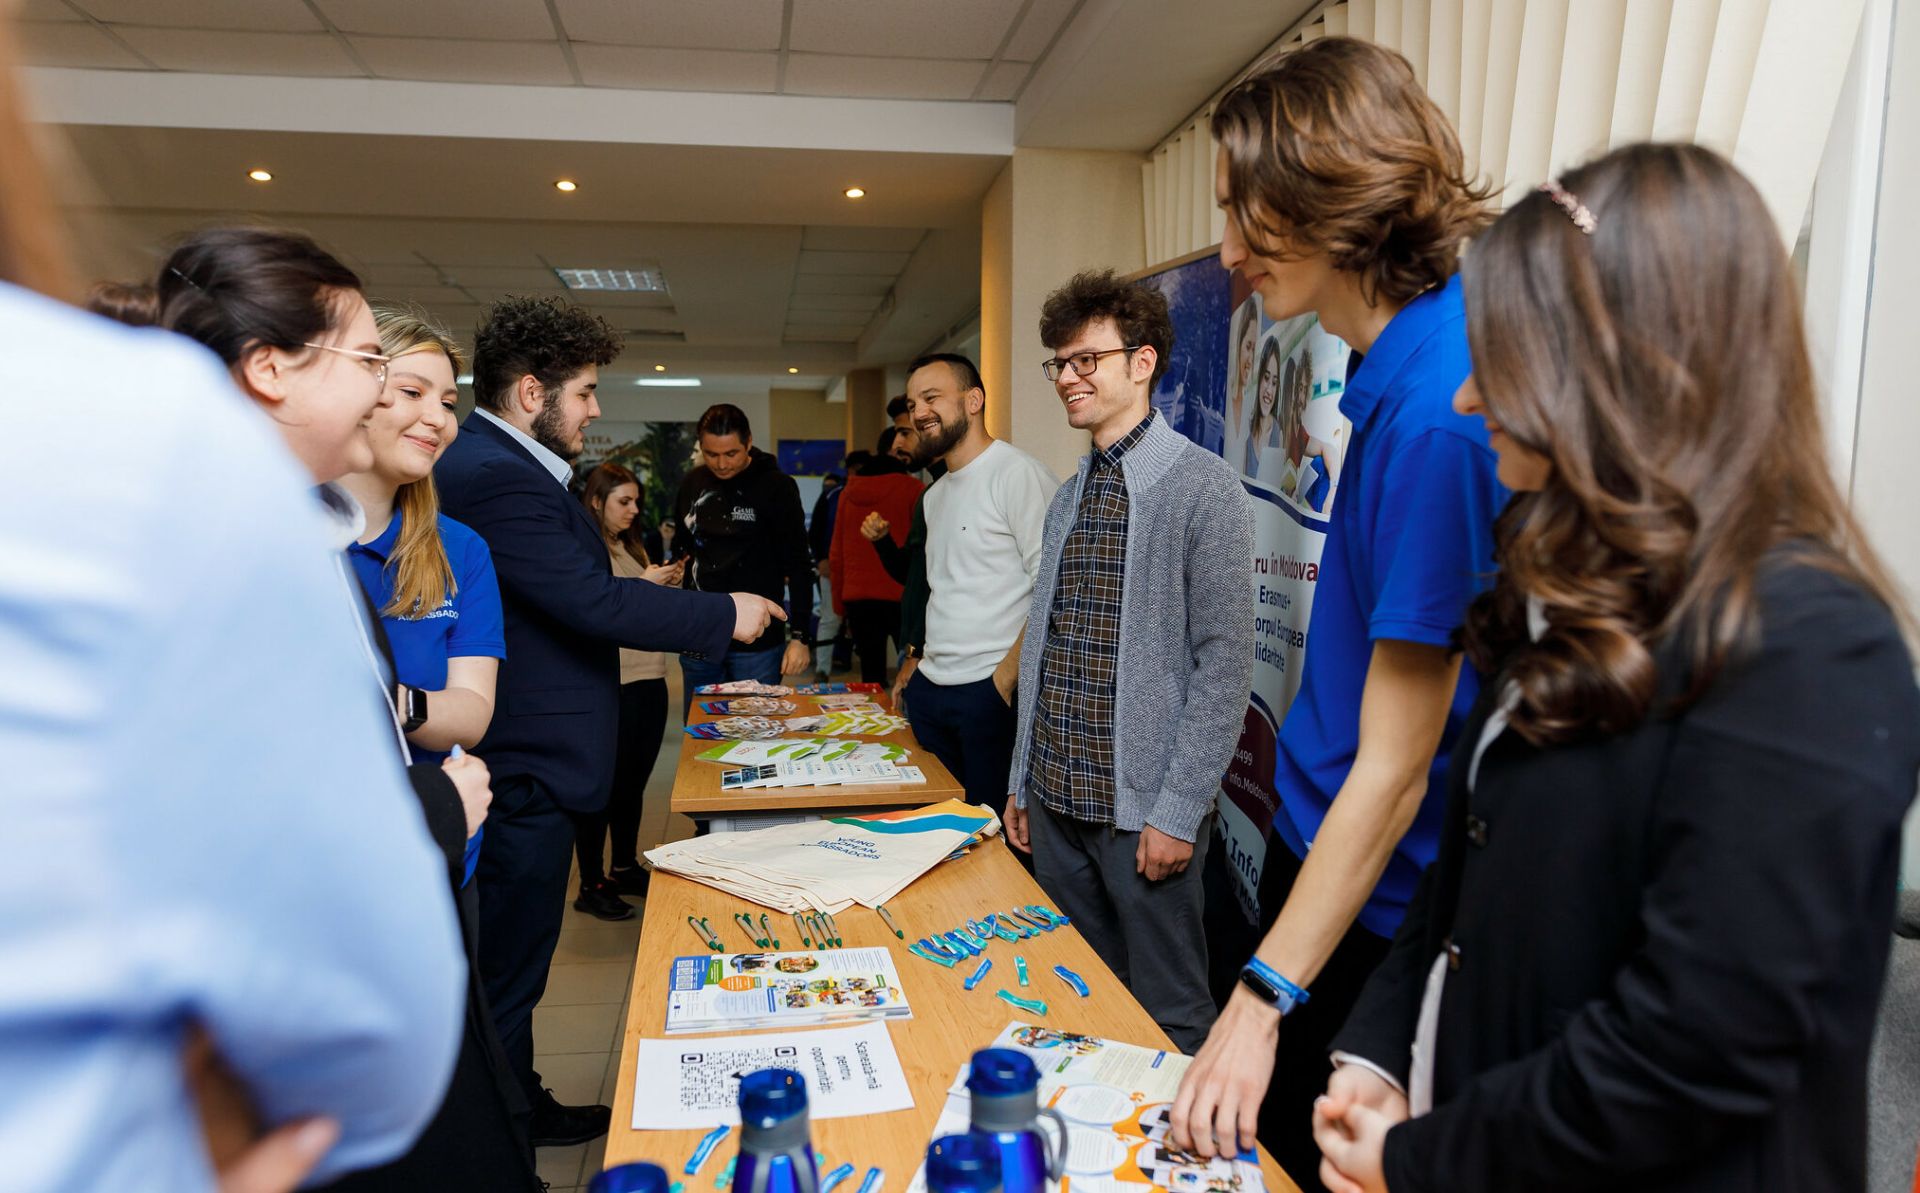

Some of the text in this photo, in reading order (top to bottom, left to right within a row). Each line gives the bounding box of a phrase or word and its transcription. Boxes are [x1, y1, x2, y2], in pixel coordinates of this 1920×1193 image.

[1255, 557, 1268, 573] ru
[1279, 554, 1319, 582] Moldova
[1260, 585, 1291, 610] Erasmus+
[1255, 616, 1305, 648] orpul Europea
[1255, 641, 1285, 673] lidaritate
[1230, 837, 1258, 887] Info
